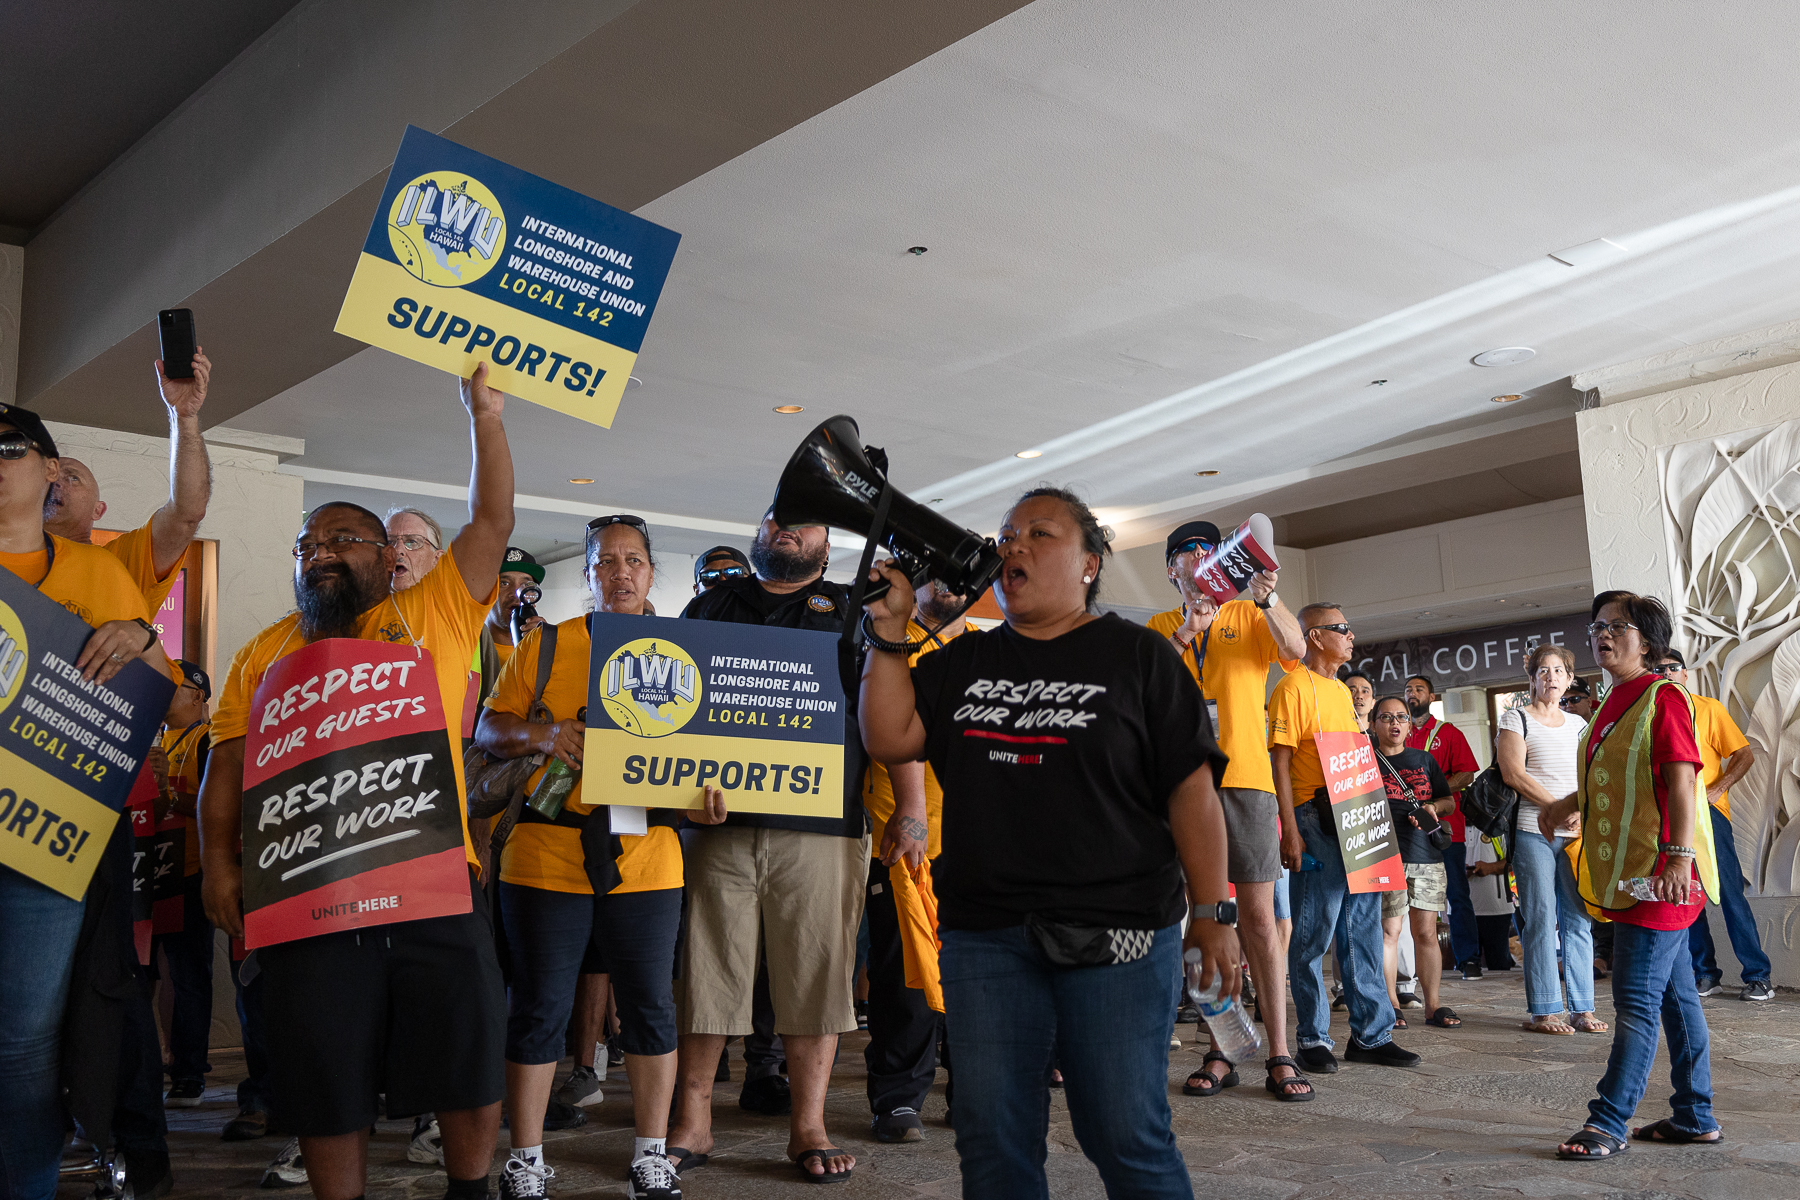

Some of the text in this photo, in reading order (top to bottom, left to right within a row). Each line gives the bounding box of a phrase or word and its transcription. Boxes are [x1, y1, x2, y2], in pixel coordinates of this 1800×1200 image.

[396, 185, 504, 260] ILWU
[429, 231, 465, 251] HAWAII
[435, 227, 464, 242] LOCAL 142
[521, 214, 634, 270] INTERNATIONAL
[513, 235, 635, 291] LONGSHORE AND
[499, 273, 614, 327] LOCAL 142
[507, 254, 646, 317] WAREHOUSE UNION
[386, 297, 607, 398] SUPPORTS!
[710, 655, 814, 675] INTERNATIONAL
[1432, 631, 1564, 674] COFFE
[41, 651, 135, 719] INTERNATIONAL
[259, 660, 416, 734] RESPECT
[607, 654, 695, 703] ILWU
[638, 692, 669, 702] HAWAII
[710, 673, 820, 693] LONGSHORE AND
[964, 678, 1107, 705] RESPECT
[31, 673, 131, 742] LONGSHORE AND
[708, 708, 813, 729] LOCAL 142
[709, 691, 837, 713] WAREHOUSE UNION
[953, 703, 1097, 729] OUR WORK
[9, 715, 107, 783] LOCAL 142
[21, 694, 137, 773] WAREHOUSE UNION
[256, 695, 426, 767] OUR GUESTS
[622, 754, 823, 795] SUPPORTS!
[989, 750, 1043, 764] UNITEHERE!
[1329, 745, 1372, 775] RESPECT
[257, 753, 434, 832] RESPECT
[1333, 777, 1353, 794] OUR
[1355, 767, 1379, 787] GUESTS
[258, 789, 440, 869] OUR WORK
[1341, 800, 1386, 831] RESPECT
[1345, 820, 1391, 852] OUR WORK
[311, 895, 402, 920] UNITEHERE!
